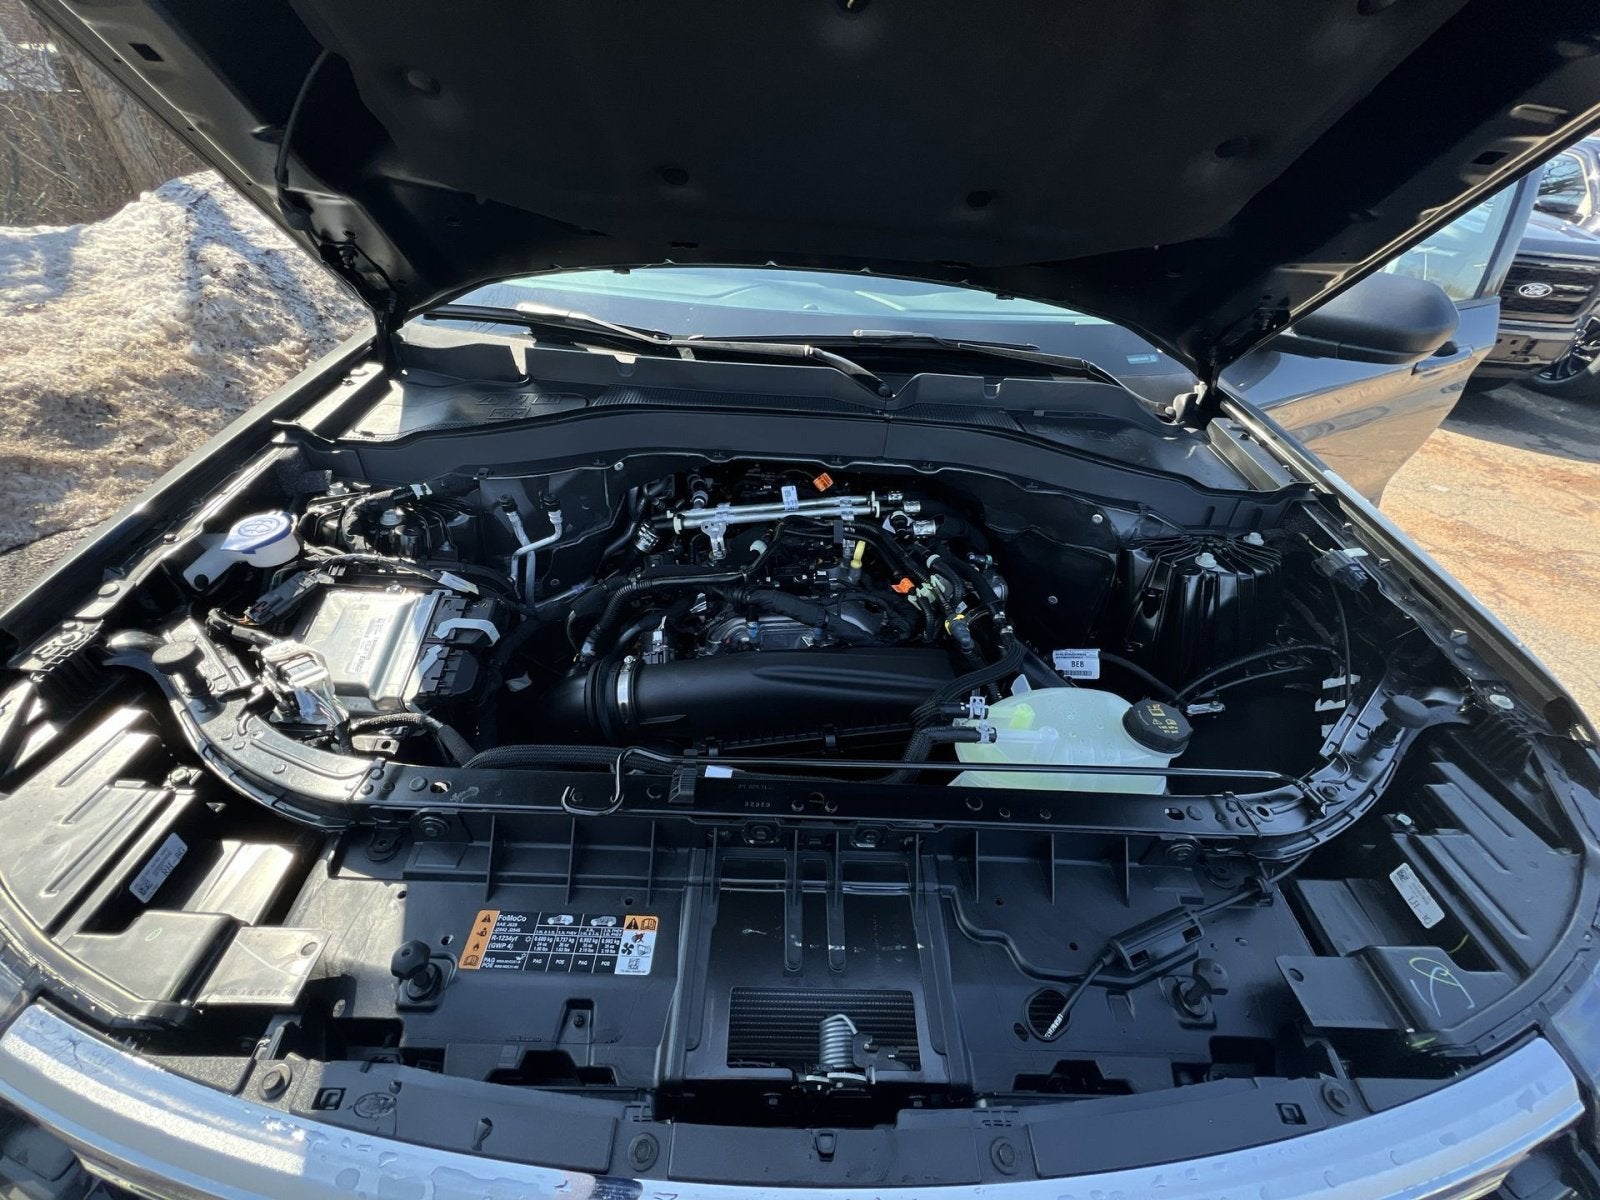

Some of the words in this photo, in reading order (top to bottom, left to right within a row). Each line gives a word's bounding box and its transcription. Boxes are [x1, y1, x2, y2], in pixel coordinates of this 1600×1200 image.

[1522, 283, 1549, 296] Ford
[498, 914, 527, 922] FoMoCo
[491, 935, 519, 943] R-1234yf
[488, 942, 507, 950] (GWP
